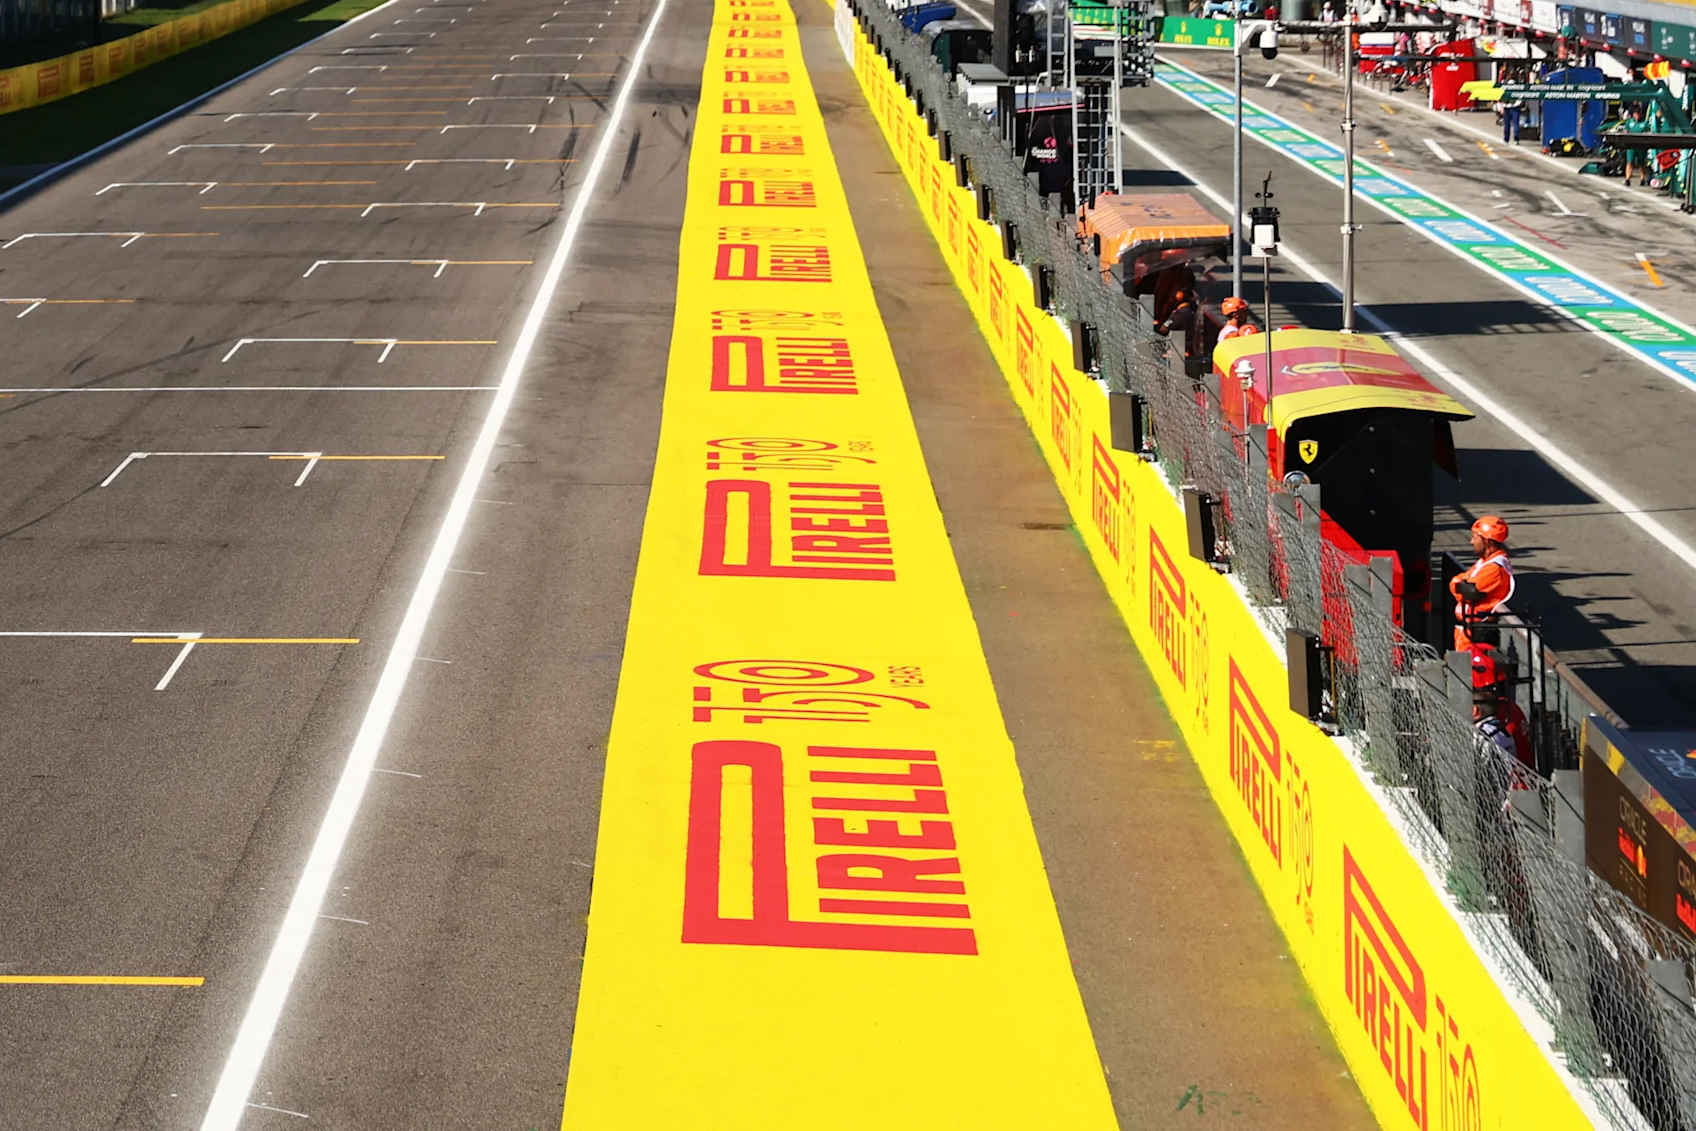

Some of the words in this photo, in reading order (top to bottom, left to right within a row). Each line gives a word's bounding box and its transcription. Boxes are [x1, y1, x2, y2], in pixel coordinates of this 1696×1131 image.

[714, 244, 832, 282] PIRELLI
[990, 257, 1003, 342] PIRELLI
[710, 335, 859, 395] PIRELLI
[1016, 303, 1035, 402] PIRELLI
[1051, 359, 1070, 476] PIRELLI
[698, 479, 896, 582] PIRELLI
[1092, 431, 1120, 565] PIRELLI
[1150, 524, 1186, 692] PIRELLI
[888, 665, 926, 688] YEARS
[1229, 653, 1282, 870] PIRELLI
[681, 740, 979, 956] PIRELLI
[1619, 796, 1647, 847] ORACLE
[1343, 842, 1428, 1131] PIRELLI
